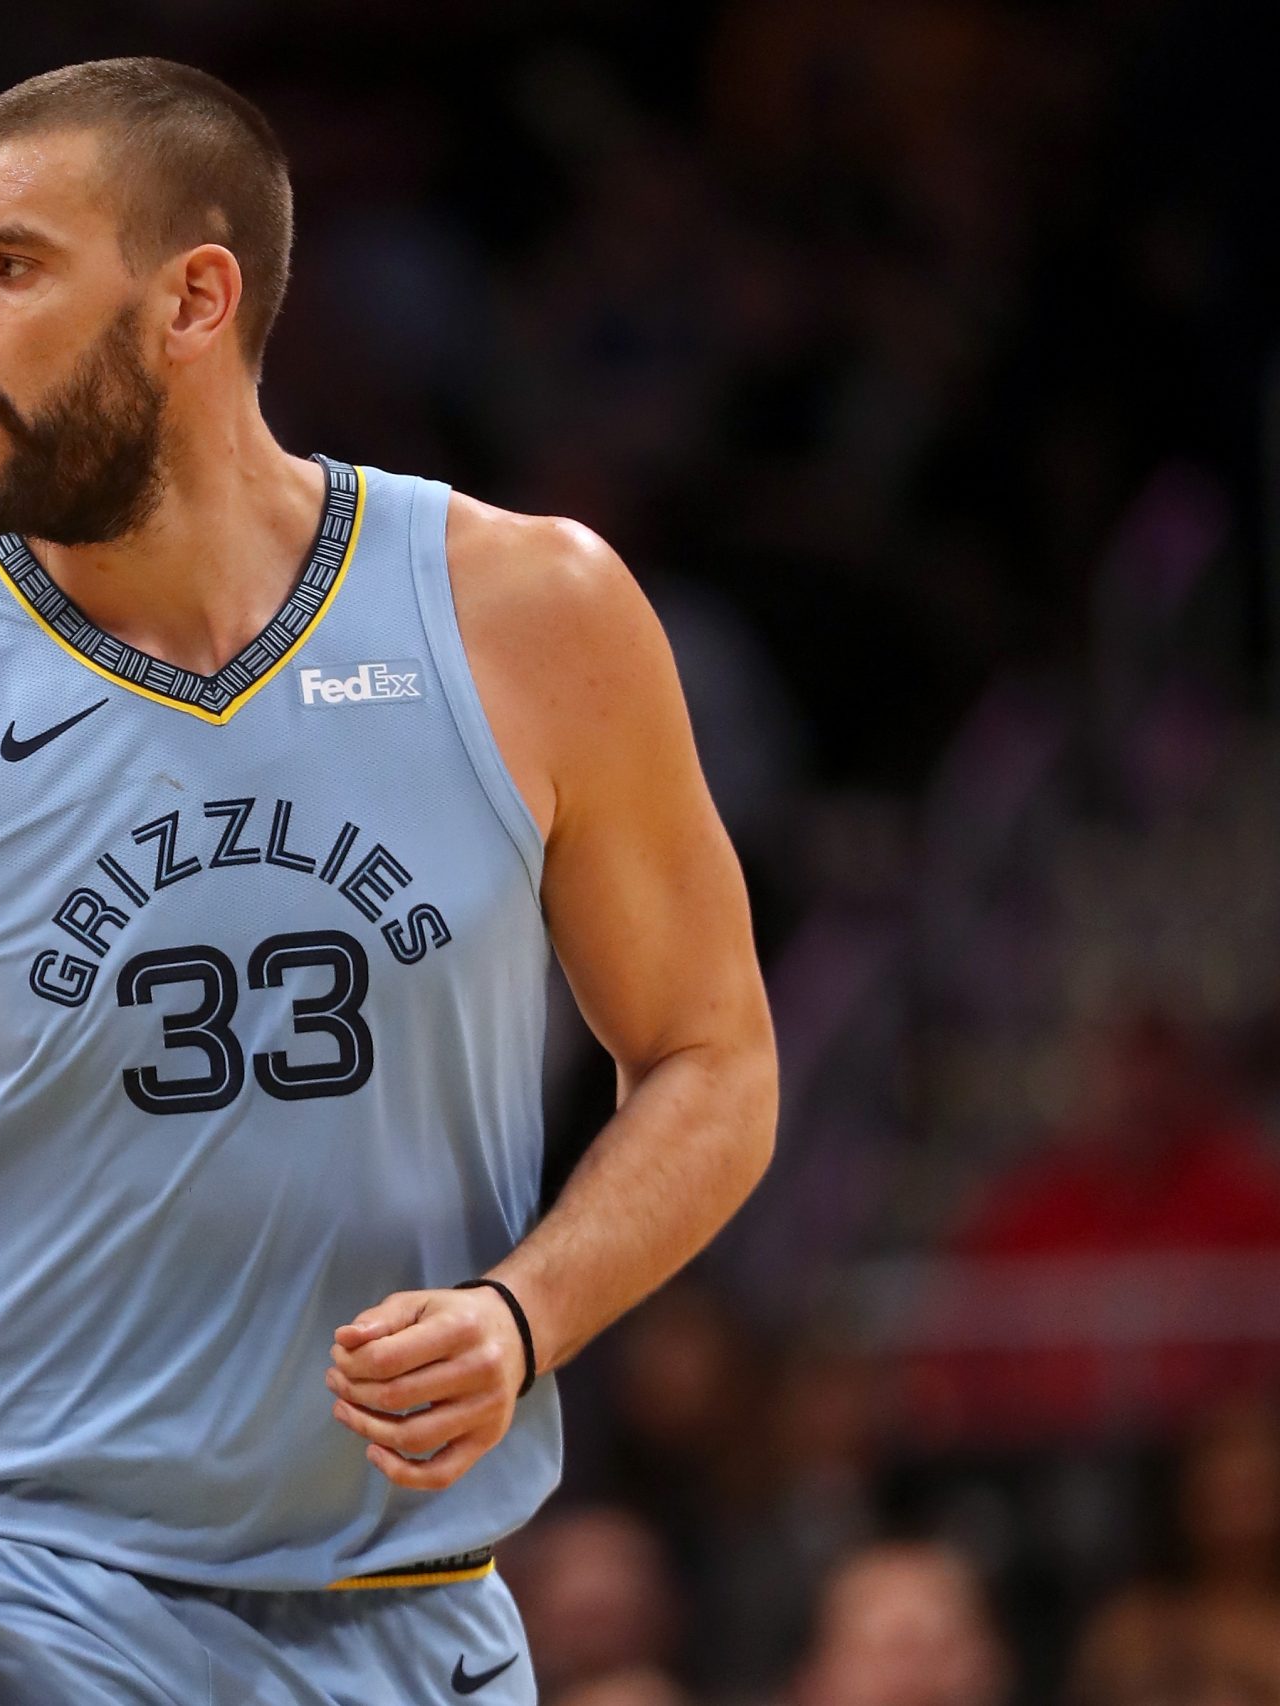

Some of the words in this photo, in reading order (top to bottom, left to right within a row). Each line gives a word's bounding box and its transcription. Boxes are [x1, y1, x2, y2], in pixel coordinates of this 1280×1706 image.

[300, 664, 421, 704] FedEx
[29, 797, 452, 1007] GRIZZLIES
[116, 929, 374, 1115] 33
